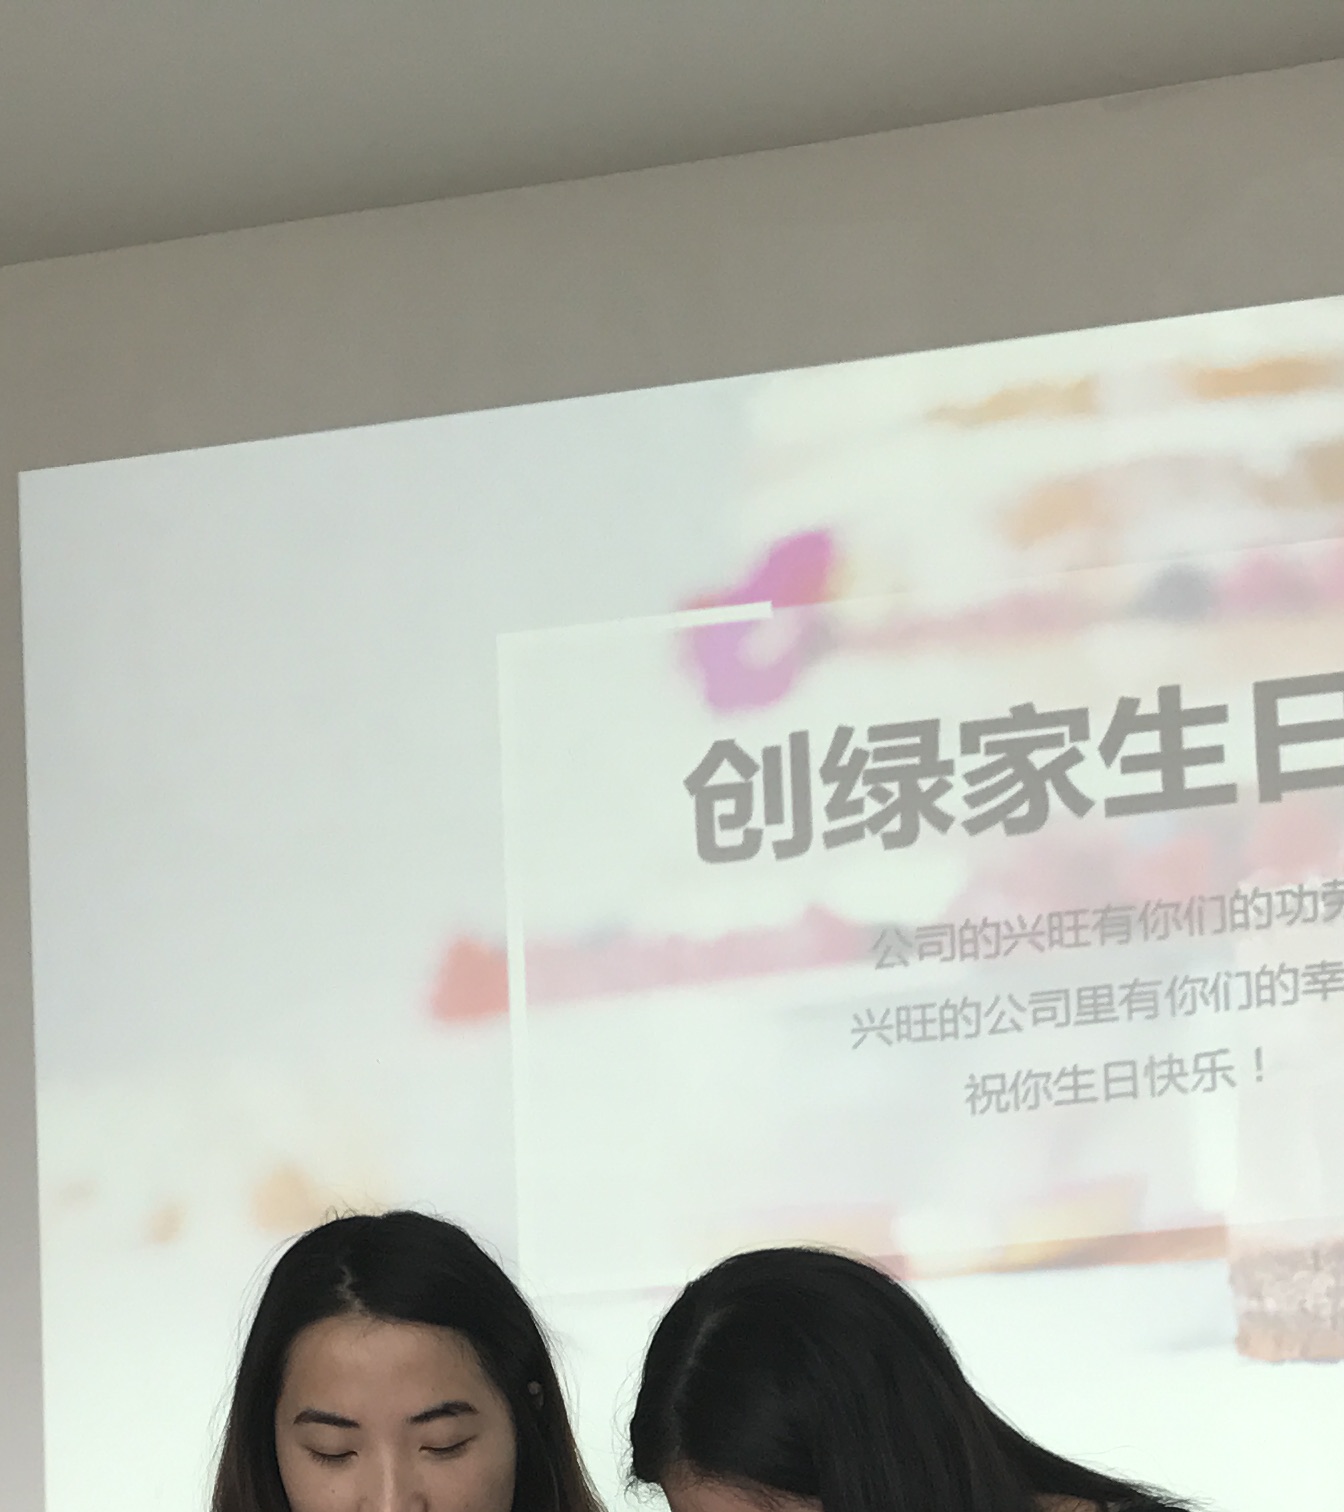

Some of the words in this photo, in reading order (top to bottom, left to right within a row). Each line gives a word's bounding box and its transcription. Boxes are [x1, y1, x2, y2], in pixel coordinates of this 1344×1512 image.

[964, 1047, 1263, 1116] 祝你生日快乐！
